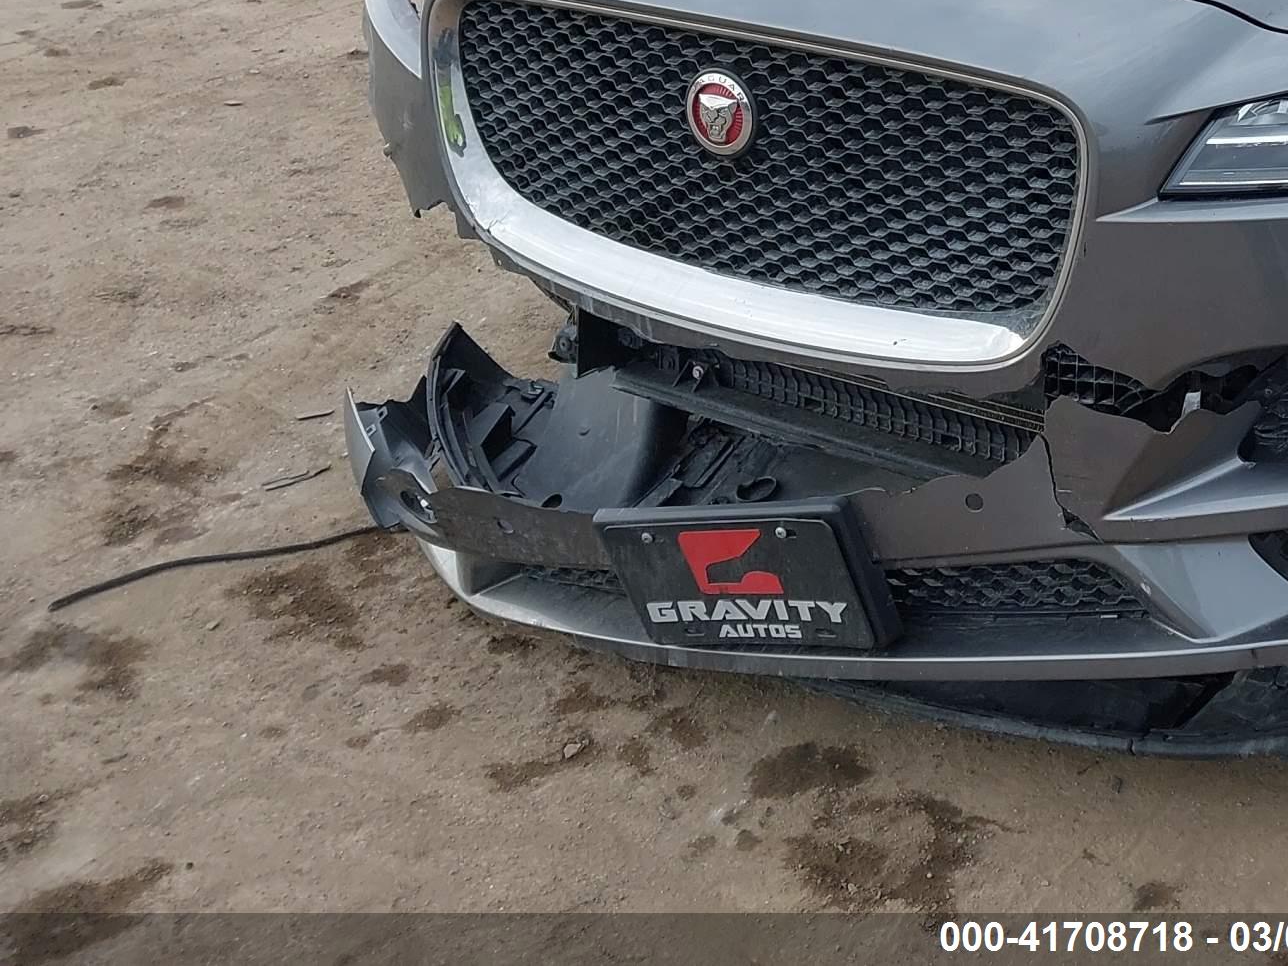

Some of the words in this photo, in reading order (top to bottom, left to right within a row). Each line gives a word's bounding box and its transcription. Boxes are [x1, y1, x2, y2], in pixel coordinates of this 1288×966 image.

[691, 75, 745, 102] JAGUAR
[646, 598, 848, 624] GRAVITY
[719, 623, 803, 639] AUTOS
